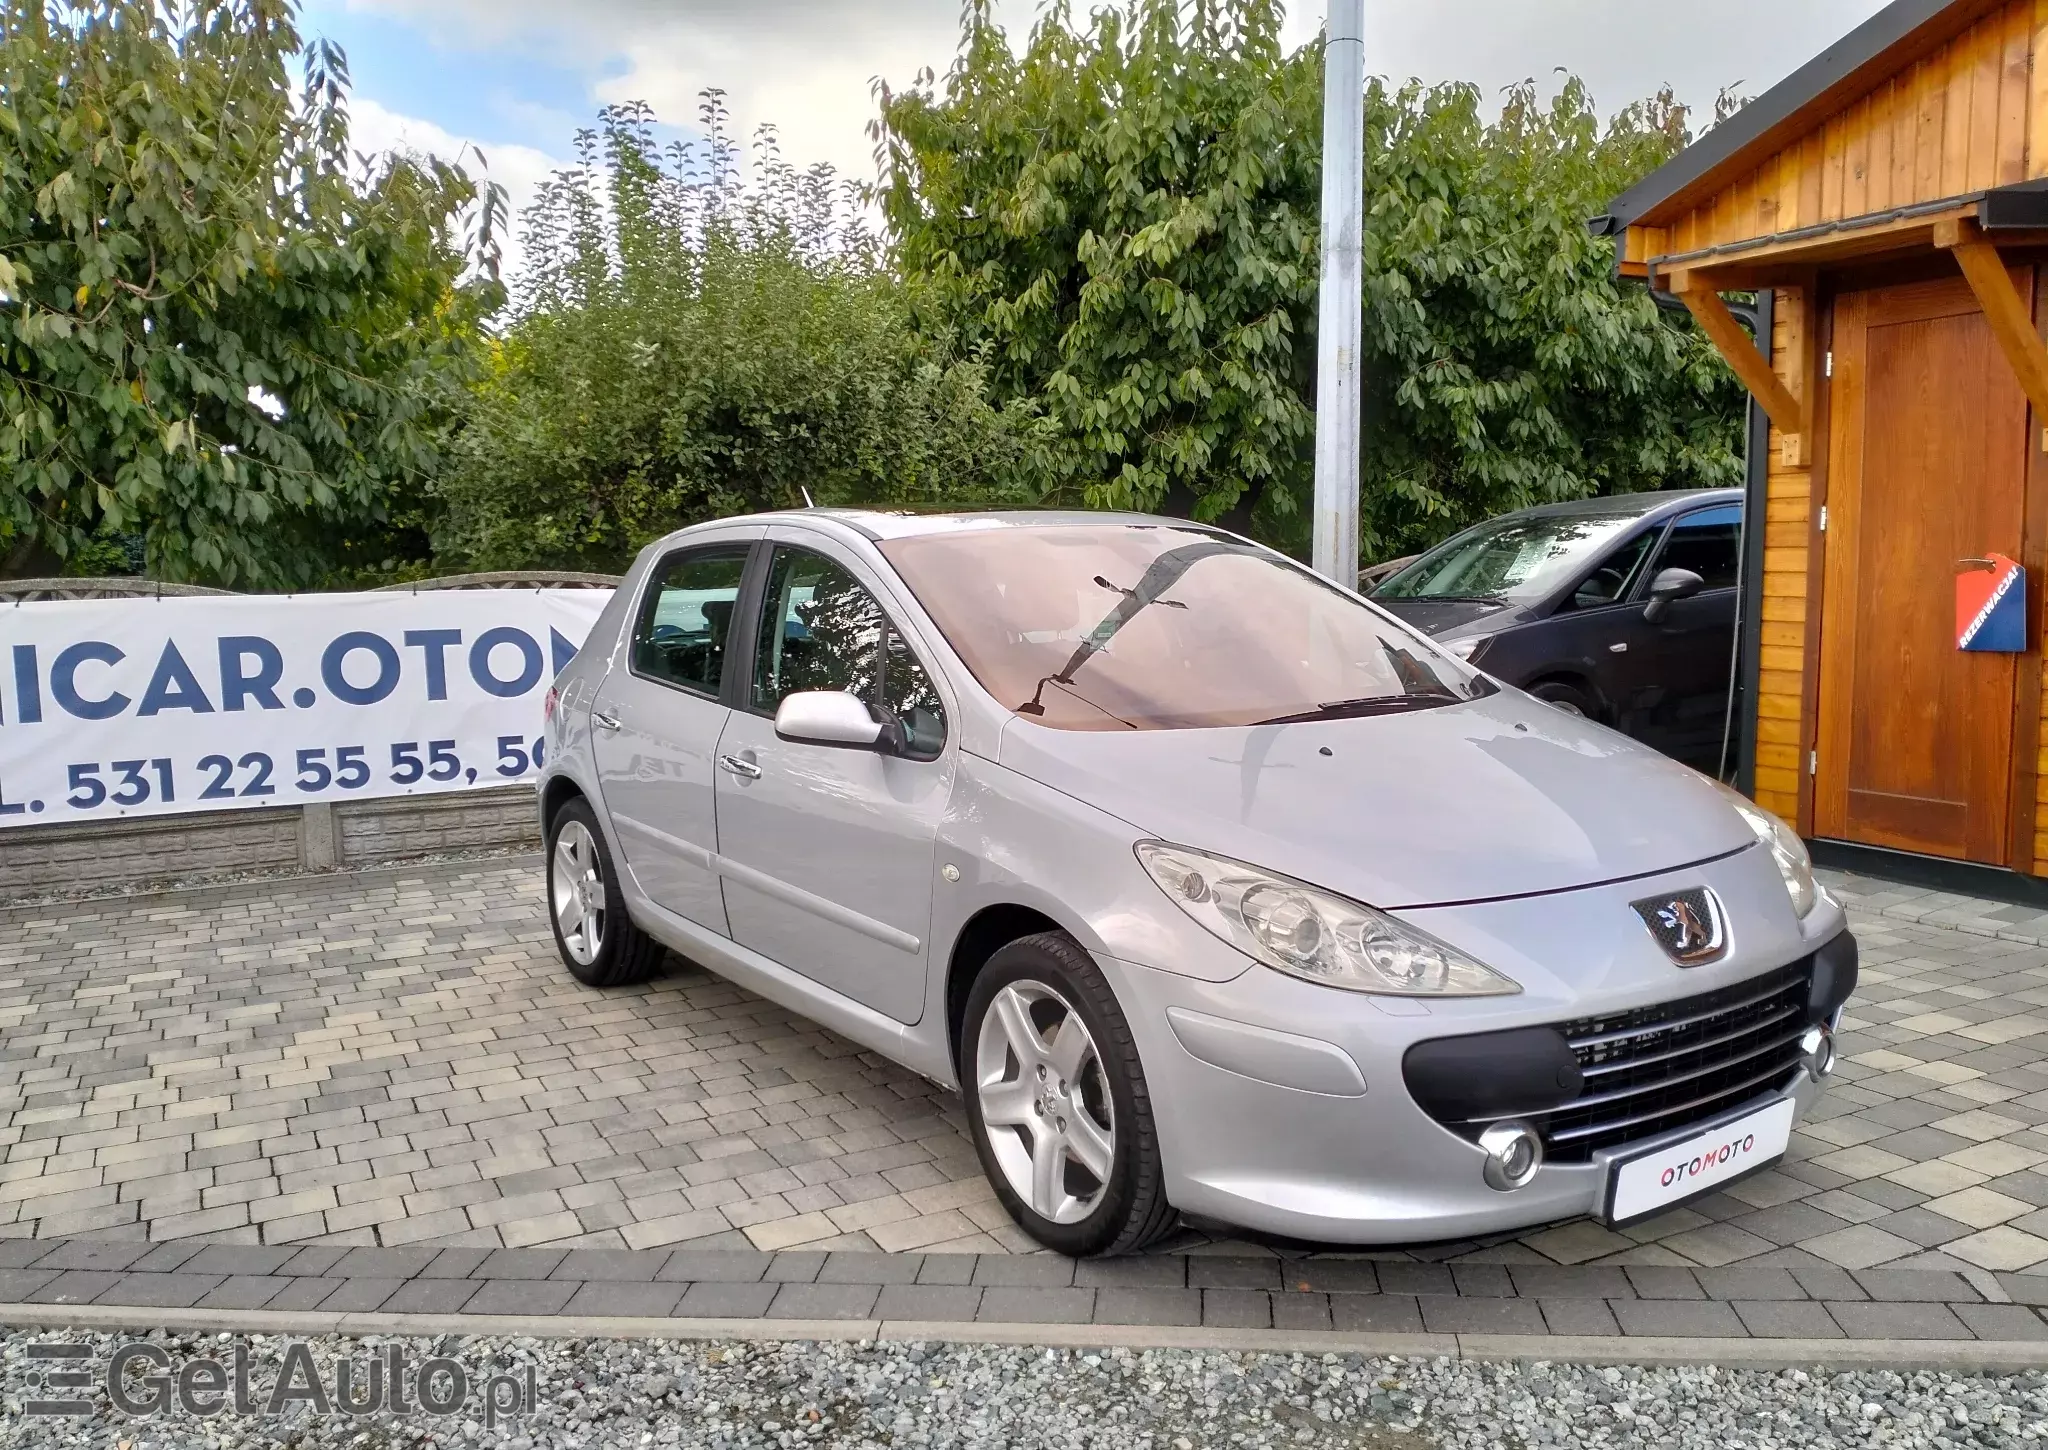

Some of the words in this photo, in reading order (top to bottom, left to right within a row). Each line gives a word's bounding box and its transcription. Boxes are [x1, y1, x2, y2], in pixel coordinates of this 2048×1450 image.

[1959, 565, 2019, 649] REZERWACJA!
[0, 626, 579, 725] ICAR.OTO
[66, 758, 175, 810] 531
[197, 752, 276, 800] 22
[296, 745, 371, 793] 55
[391, 739, 478, 785] 55,
[495, 735, 545, 777] 5
[1661, 1133, 1755, 1187] OTOMOTO
